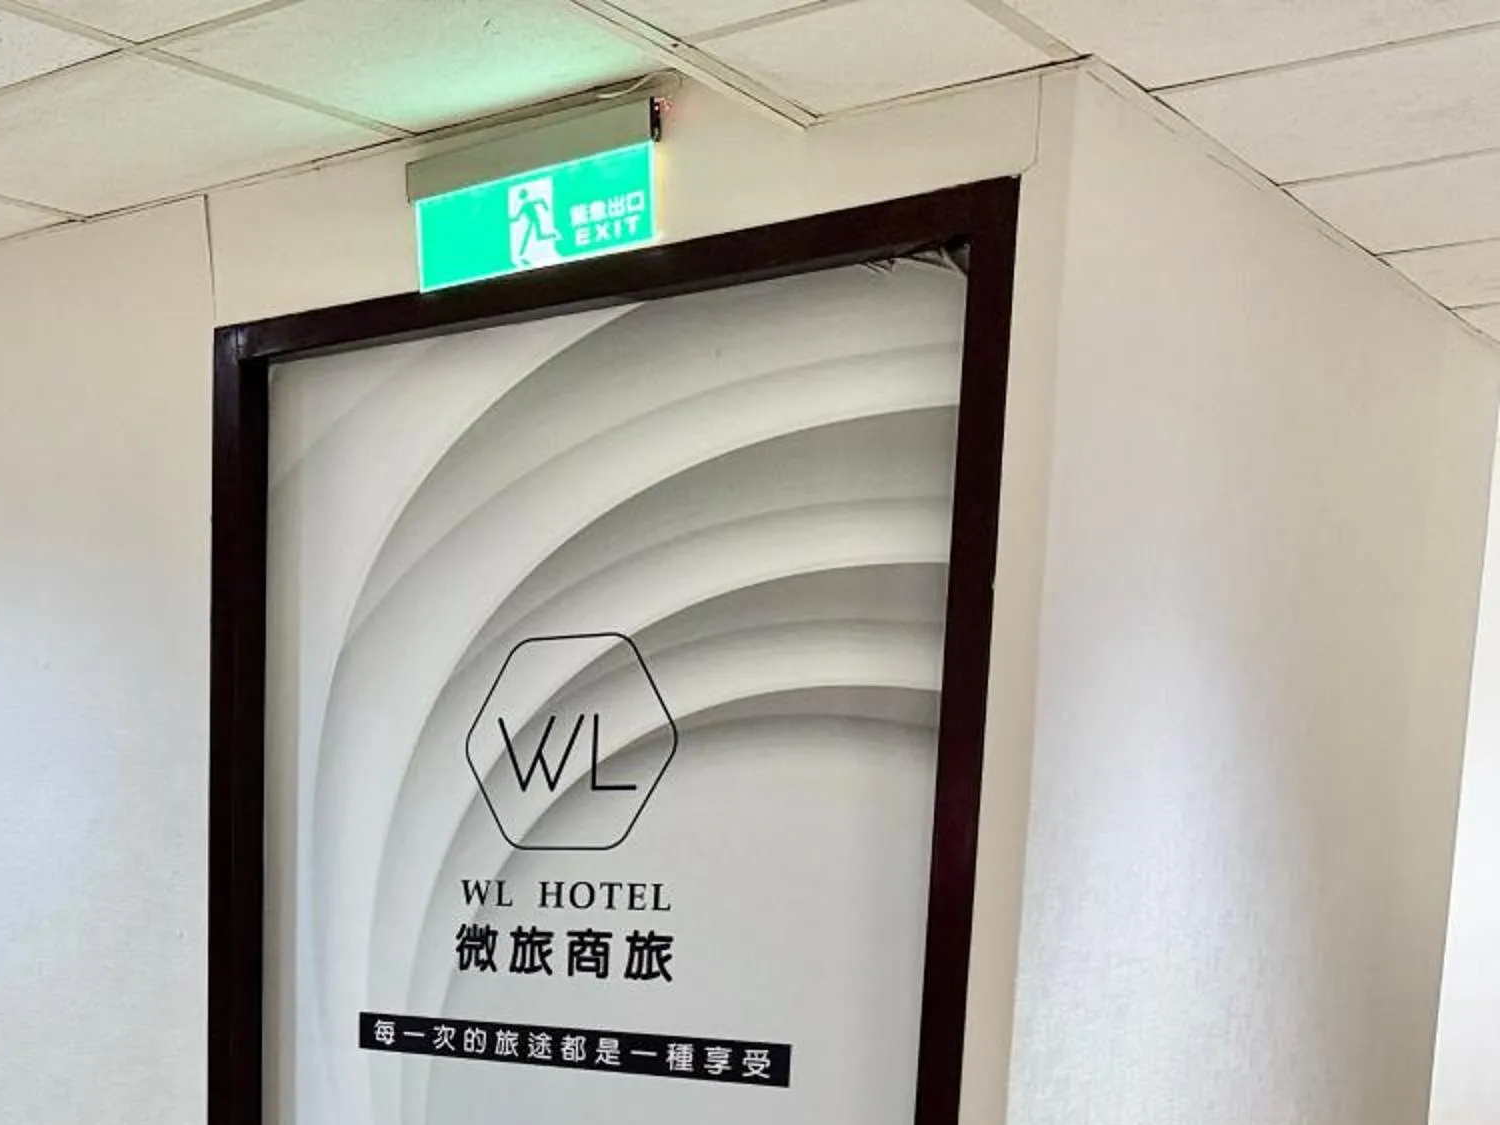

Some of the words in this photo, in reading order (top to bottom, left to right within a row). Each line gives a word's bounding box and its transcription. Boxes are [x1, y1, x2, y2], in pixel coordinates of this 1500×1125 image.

[575, 215, 640, 246] EXIT
[498, 713, 637, 792] WL
[461, 879, 514, 908] WL
[538, 880, 672, 912] HOTEL
[455, 923, 675, 983] 微旅商旅
[374, 1018, 773, 1080] 每一次的旅途都是一種享受
